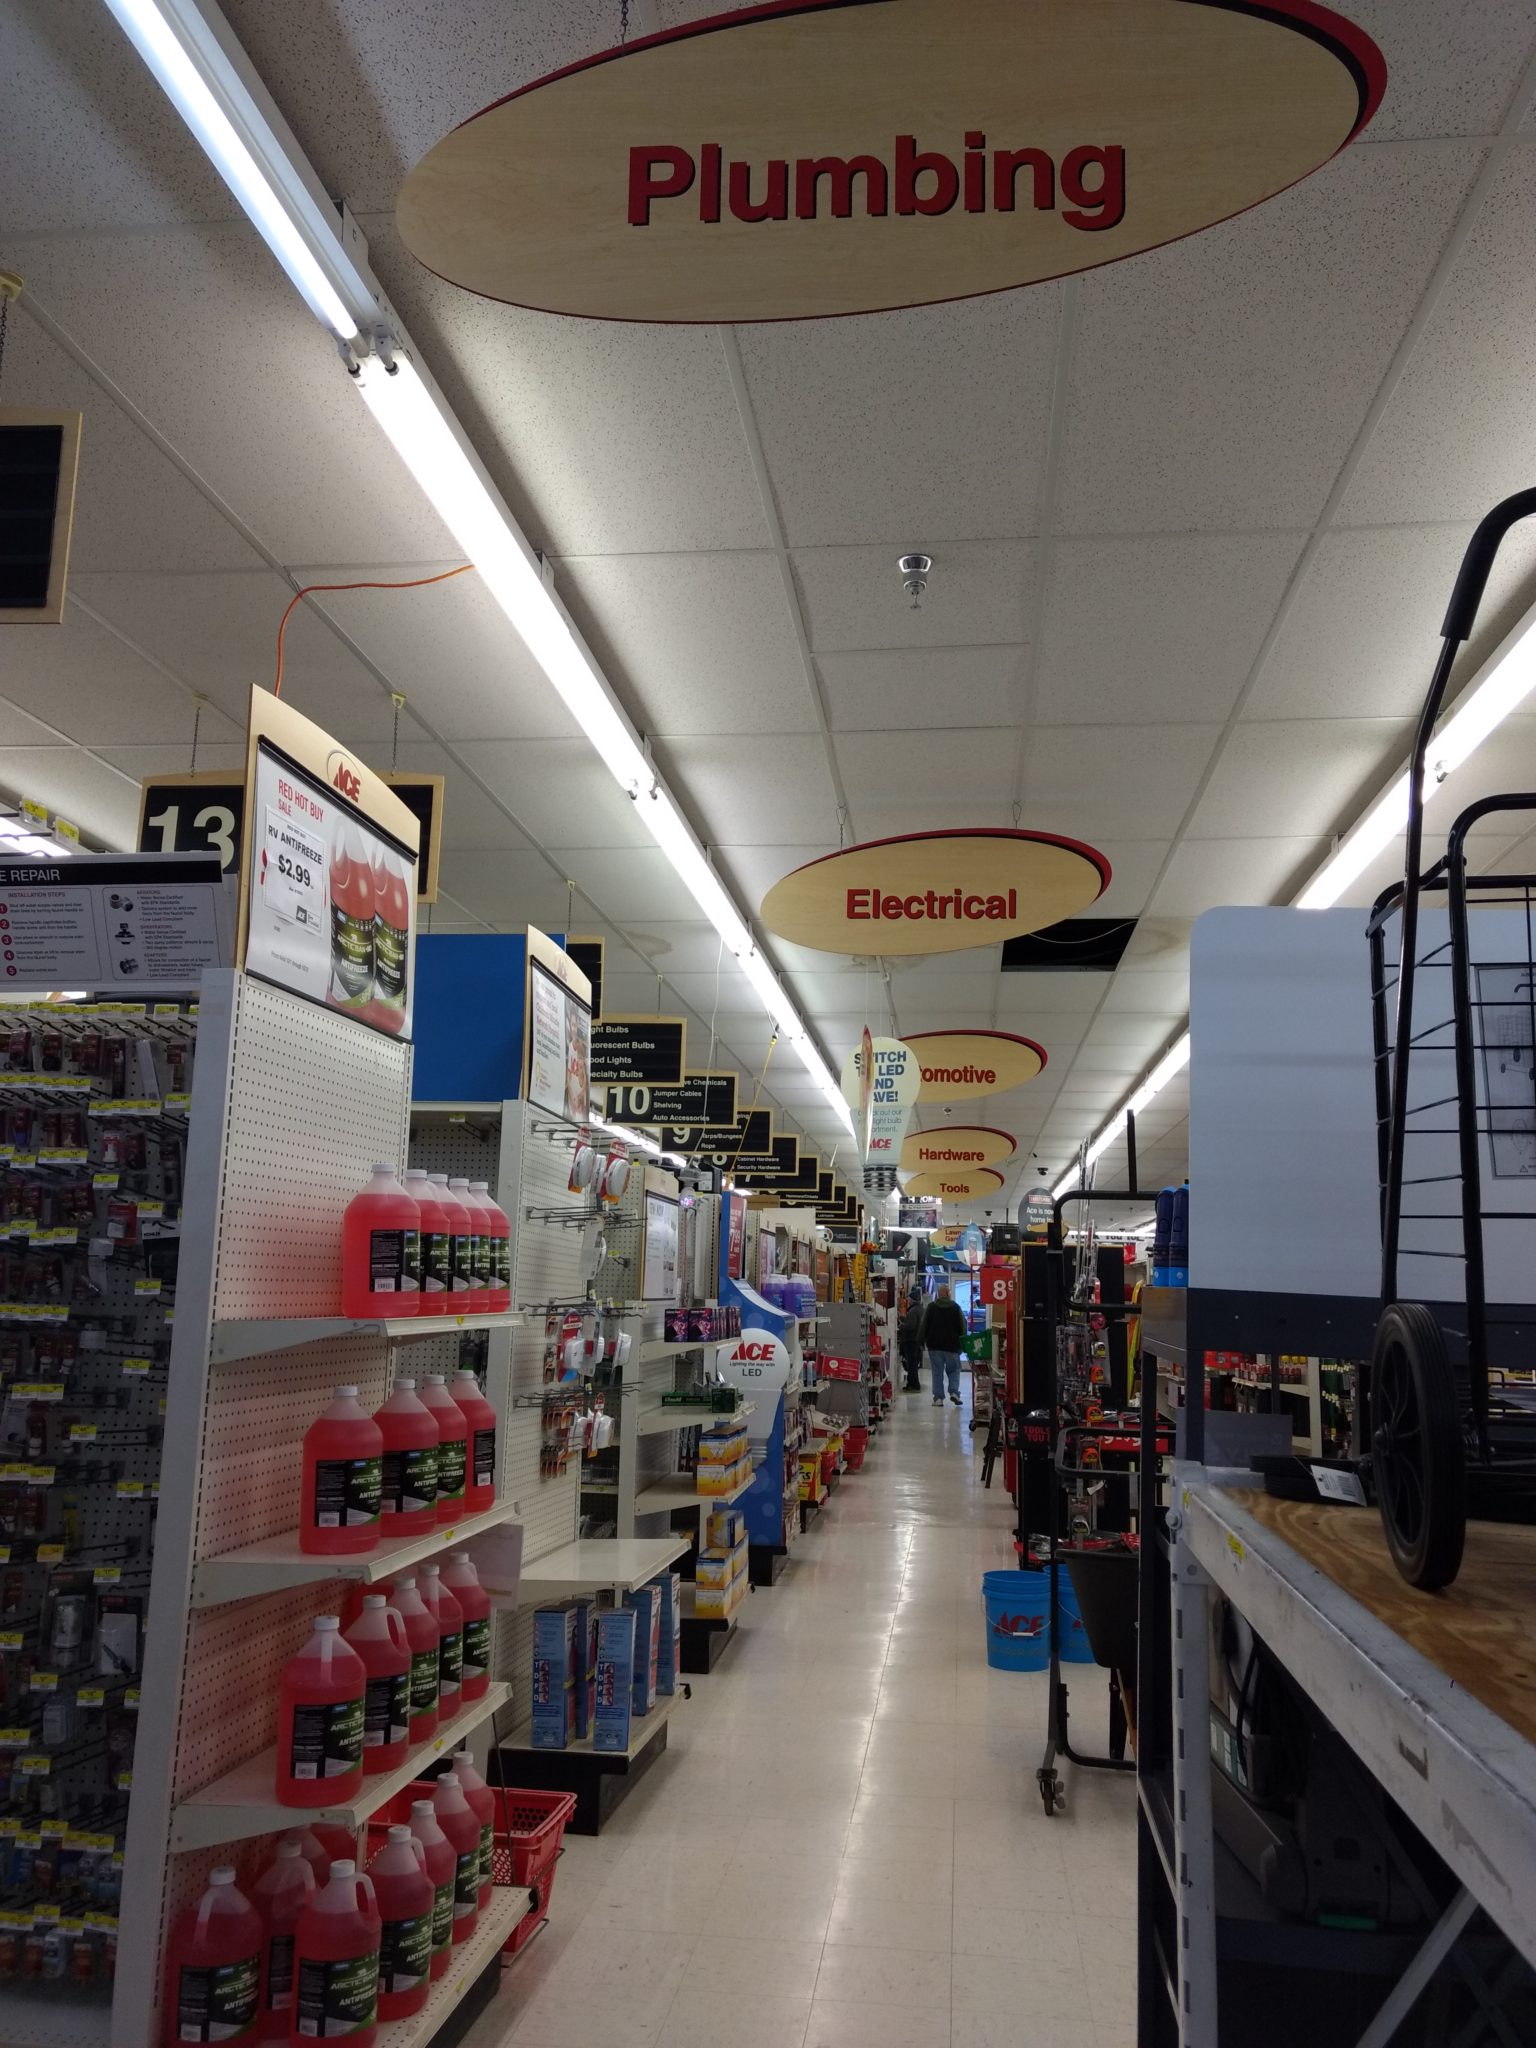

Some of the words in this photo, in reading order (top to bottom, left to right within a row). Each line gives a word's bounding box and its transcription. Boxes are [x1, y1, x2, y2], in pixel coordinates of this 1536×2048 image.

[627, 130, 1126, 232] Plumbing
[333, 761, 361, 803] ACE
[278, 778, 293, 802] RED
[295, 791, 308, 812] HOT
[310, 802, 324, 823] BUY
[278, 798, 292, 817] SALE
[148, 805, 237, 871] 13
[268, 825, 279, 839] RV
[281, 832, 323, 866] ANTIFREEZE
[10, 869, 61, 882] REPAIR
[278, 853, 311, 888] $2.99
[846, 888, 1018, 920] Electrical
[591, 1026, 604, 1035] ght
[605, 1025, 629, 1033] Bulbs
[632, 1041, 655, 1049] Bulbs
[606, 1056, 633, 1065] Lights
[854, 1051, 907, 1064] SITCH
[591, 1070, 618, 1079] ecialty
[619, 1070, 643, 1078] Bulbs
[878, 1064, 905, 1076] LED
[919, 1065, 996, 1084] omotive
[653, 1090, 678, 1098] Jumper
[873, 1091, 899, 1102] AVE!
[609, 1087, 650, 1115] 10
[653, 1101, 682, 1109] Shelving
[919, 1148, 985, 1162] Hardware
[939, 1182, 970, 1194] Tools
[1026, 1206, 1038, 1214] Ace
[730, 1340, 776, 1361] ACE
[742, 1368, 762, 1377] LED
[1023, 1425, 1051, 1434] TOOLS
